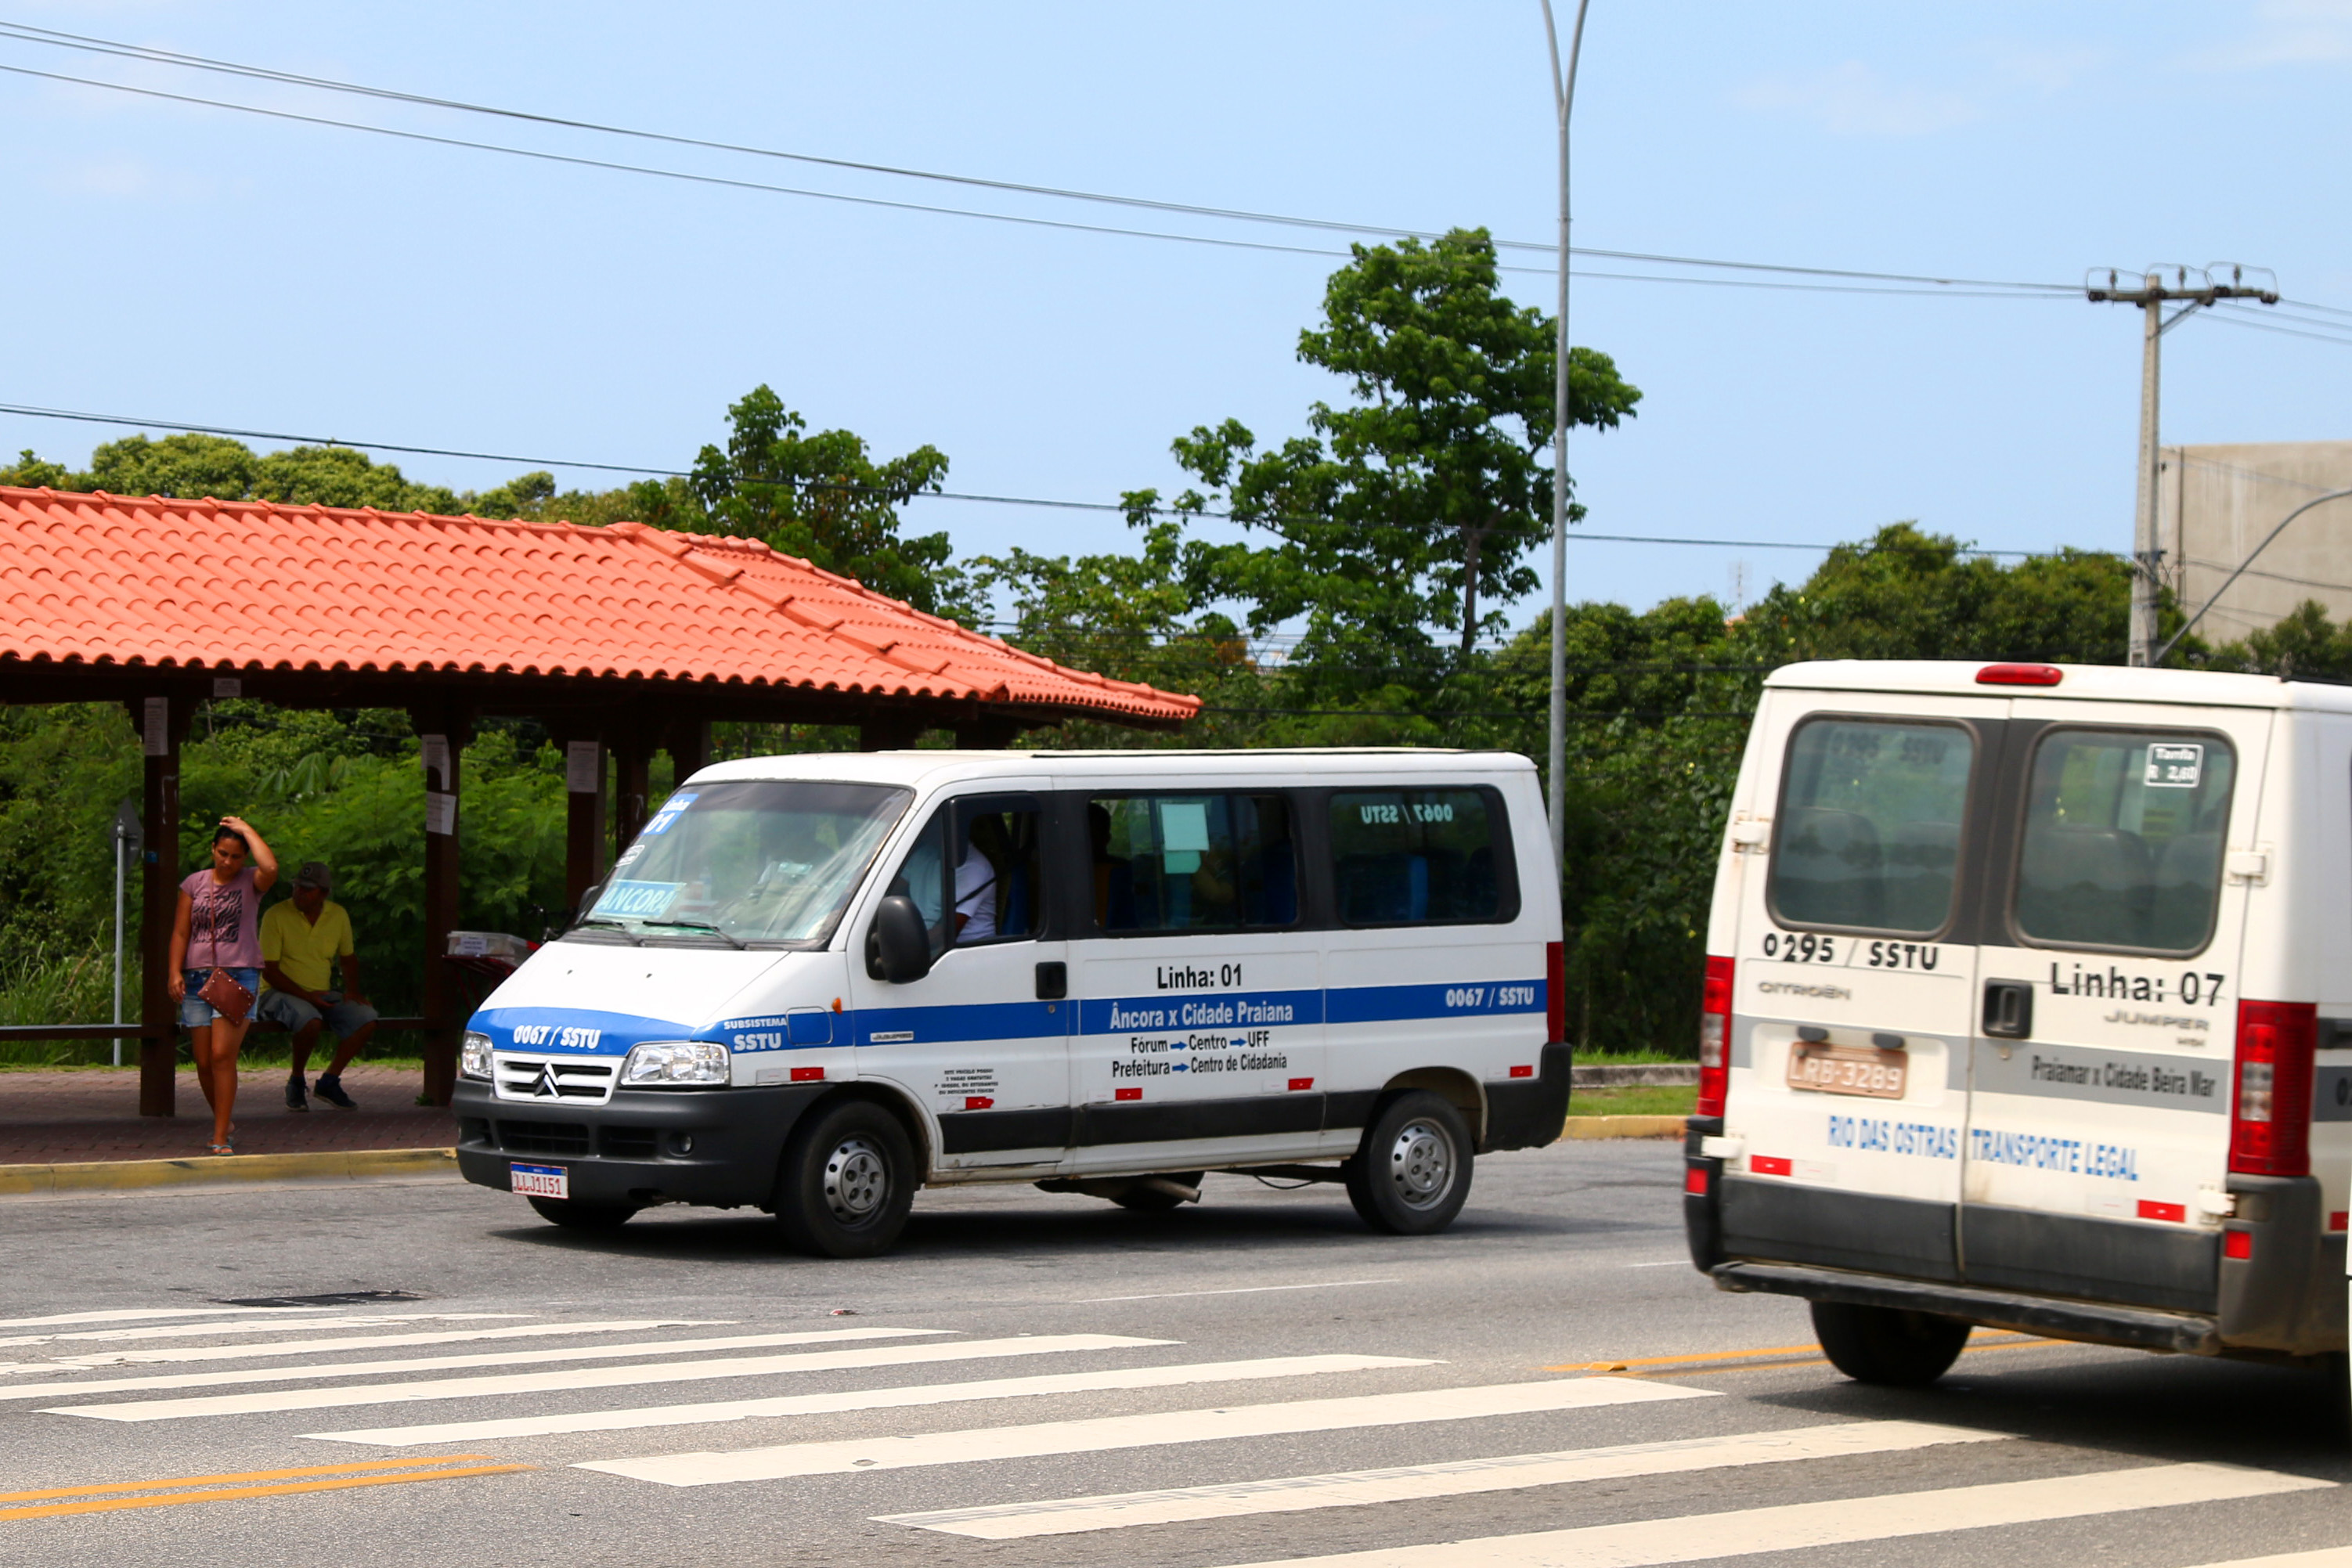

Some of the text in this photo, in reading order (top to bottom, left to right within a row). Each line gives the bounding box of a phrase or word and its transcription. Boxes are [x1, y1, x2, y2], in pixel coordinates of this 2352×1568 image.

[644, 813, 676, 834] 01
[1765, 933, 1834, 962] 0295
[1869, 941, 1938, 970] SSTU
[1157, 963, 1243, 989] Linha: 01
[2051, 962, 2224, 1007] Linha: 07
[1446, 987, 1535, 1007] 0067 / SSTU
[723, 1017, 787, 1030] SUBSISTEMA
[1109, 1000, 1293, 1029] Âncora x Cidade Praiana
[2104, 1011, 2210, 1031] JUMPER
[513, 1025, 546, 1045] 0067
[560, 1026, 601, 1049] SSTU
[734, 1032, 781, 1051] SSTU
[1131, 1030, 1270, 1054] Fórum Centro UFF
[1113, 1052, 1287, 1078] Prefeitura Centro de Cidadania
[1788, 1057, 1903, 1091] LRB-3289
[2032, 1055, 2091, 1085] Praiamar
[2092, 1068, 2101, 1086] x
[2105, 1062, 2148, 1090] Cidade
[2152, 1066, 2187, 1094] Beira
[2336, 1077, 2352, 1105] 0
[1828, 1116, 2139, 1181] RIO DAS OSTRAS TRANSPORTE LEGAL
